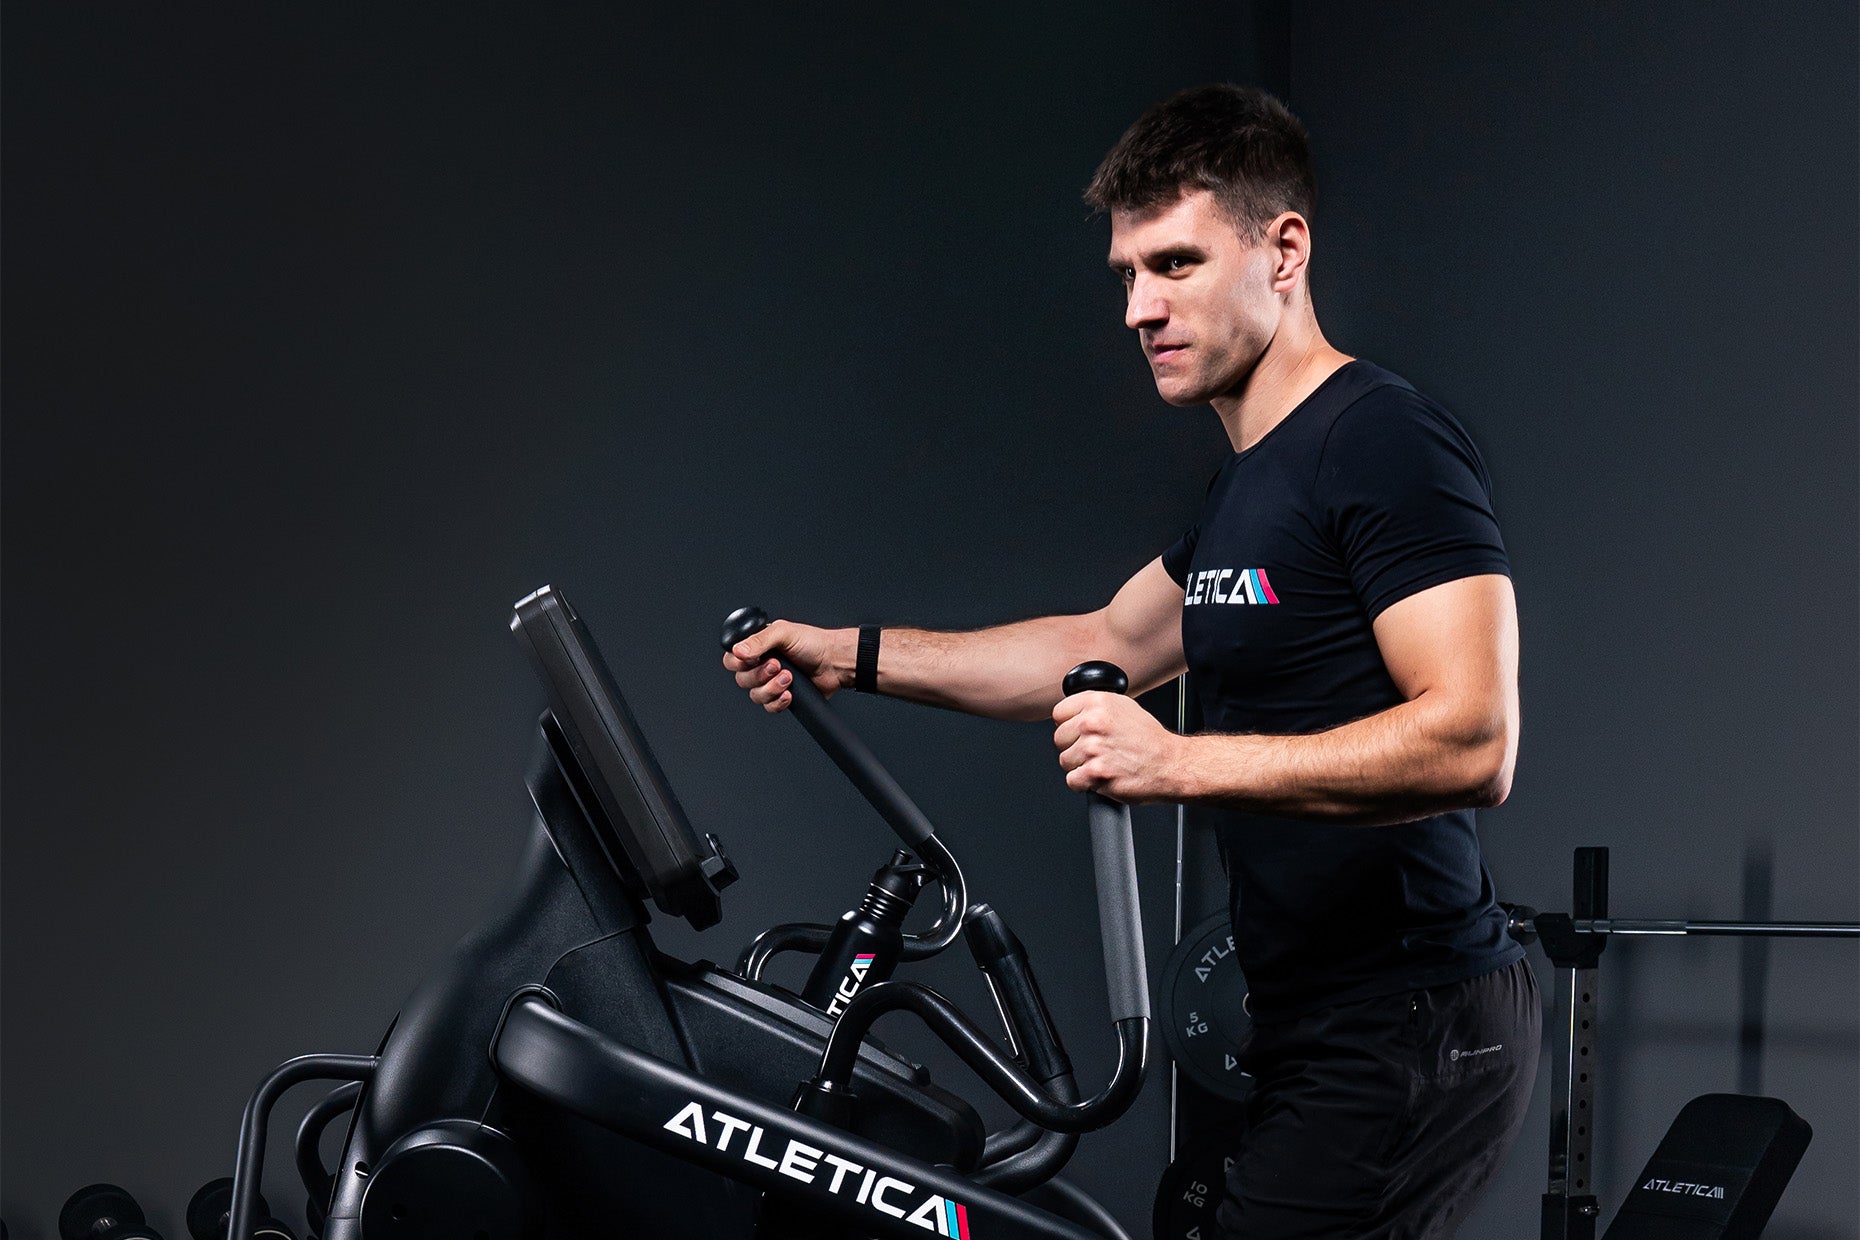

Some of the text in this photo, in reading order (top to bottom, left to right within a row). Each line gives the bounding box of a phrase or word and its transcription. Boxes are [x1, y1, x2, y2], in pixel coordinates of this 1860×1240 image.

[1189, 1011, 1199, 1024] 5
[1186, 1022, 1209, 1038] KG
[1191, 1181, 1208, 1194] 10
[1642, 1178, 1725, 1199] ATLETICA
[1183, 1191, 1206, 1208] KG
